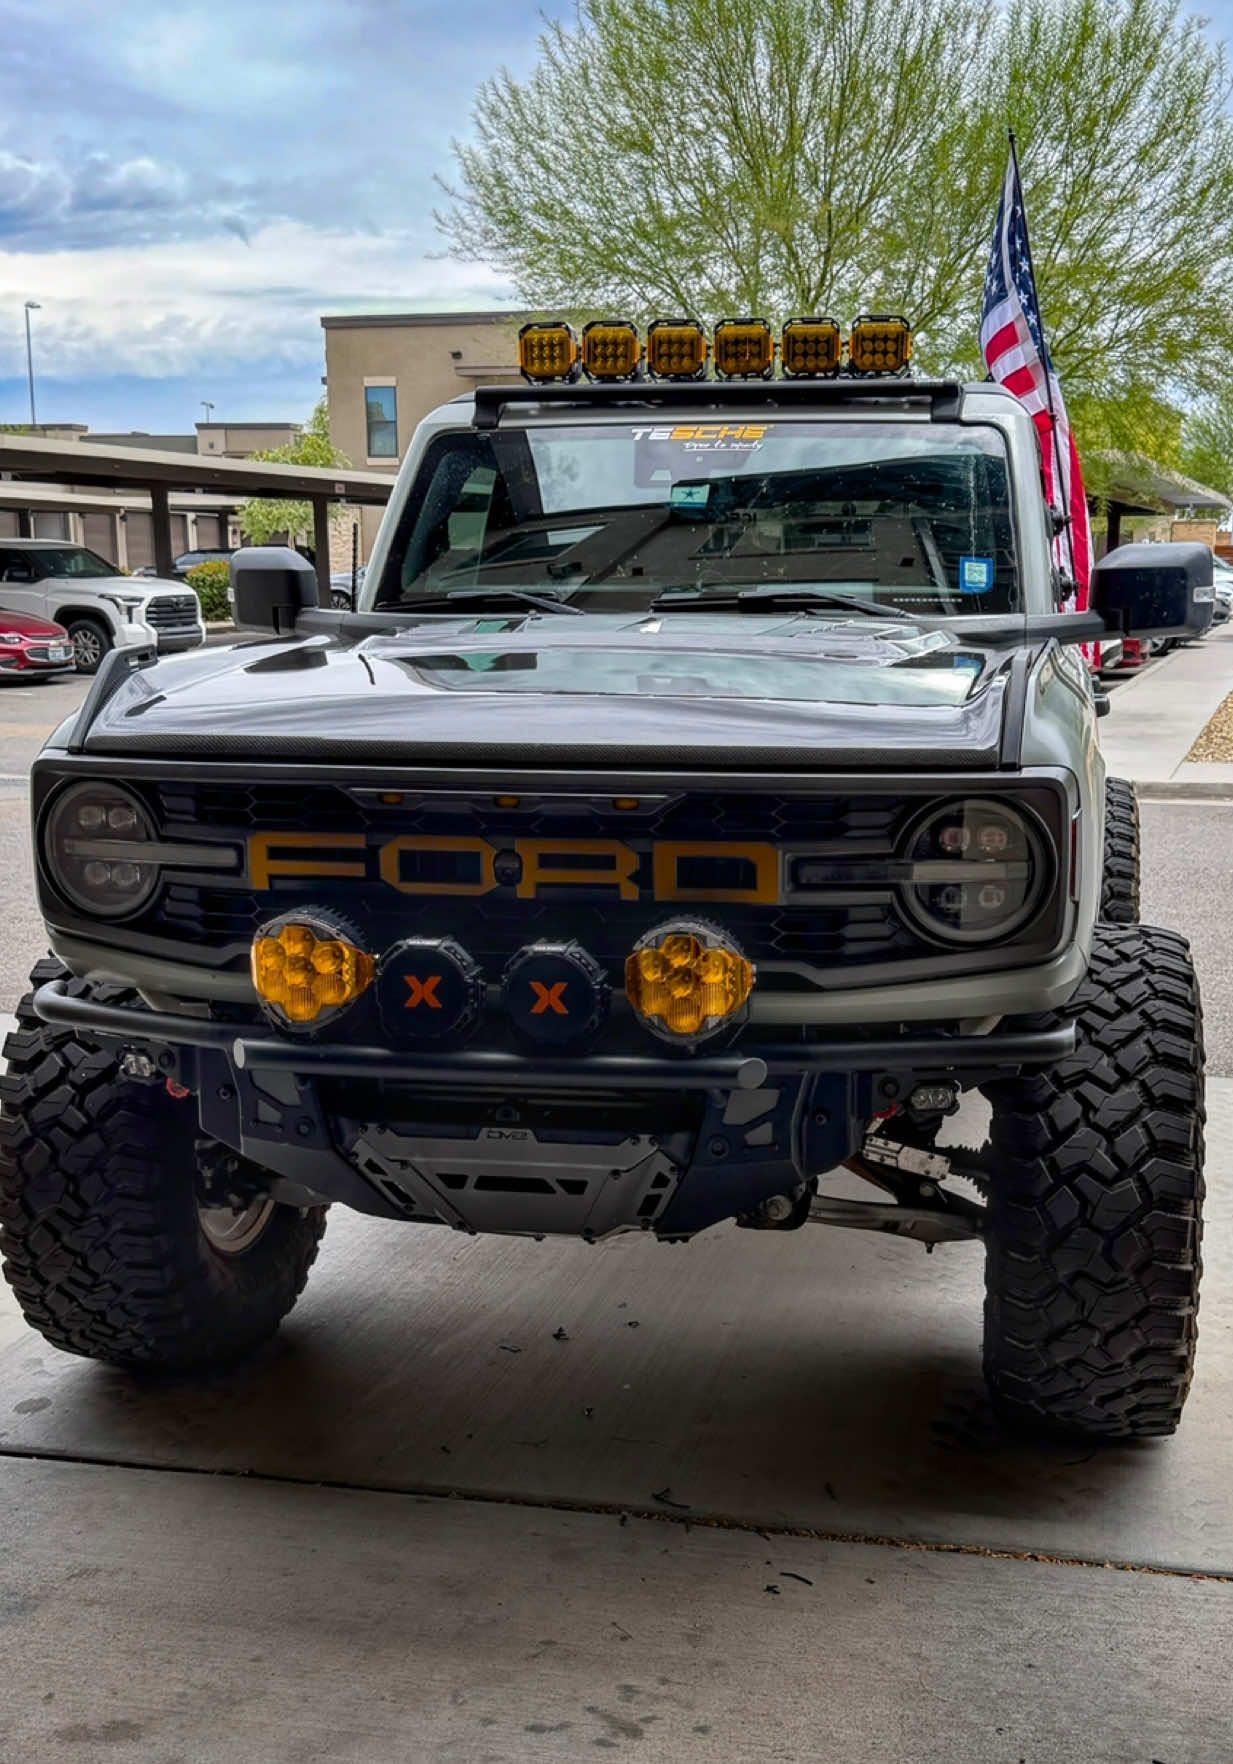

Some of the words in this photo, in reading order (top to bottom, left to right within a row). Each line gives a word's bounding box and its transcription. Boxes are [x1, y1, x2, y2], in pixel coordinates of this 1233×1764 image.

[247, 831, 782, 905] FORD
[403, 975, 443, 1009] X
[528, 981, 570, 1015] X
